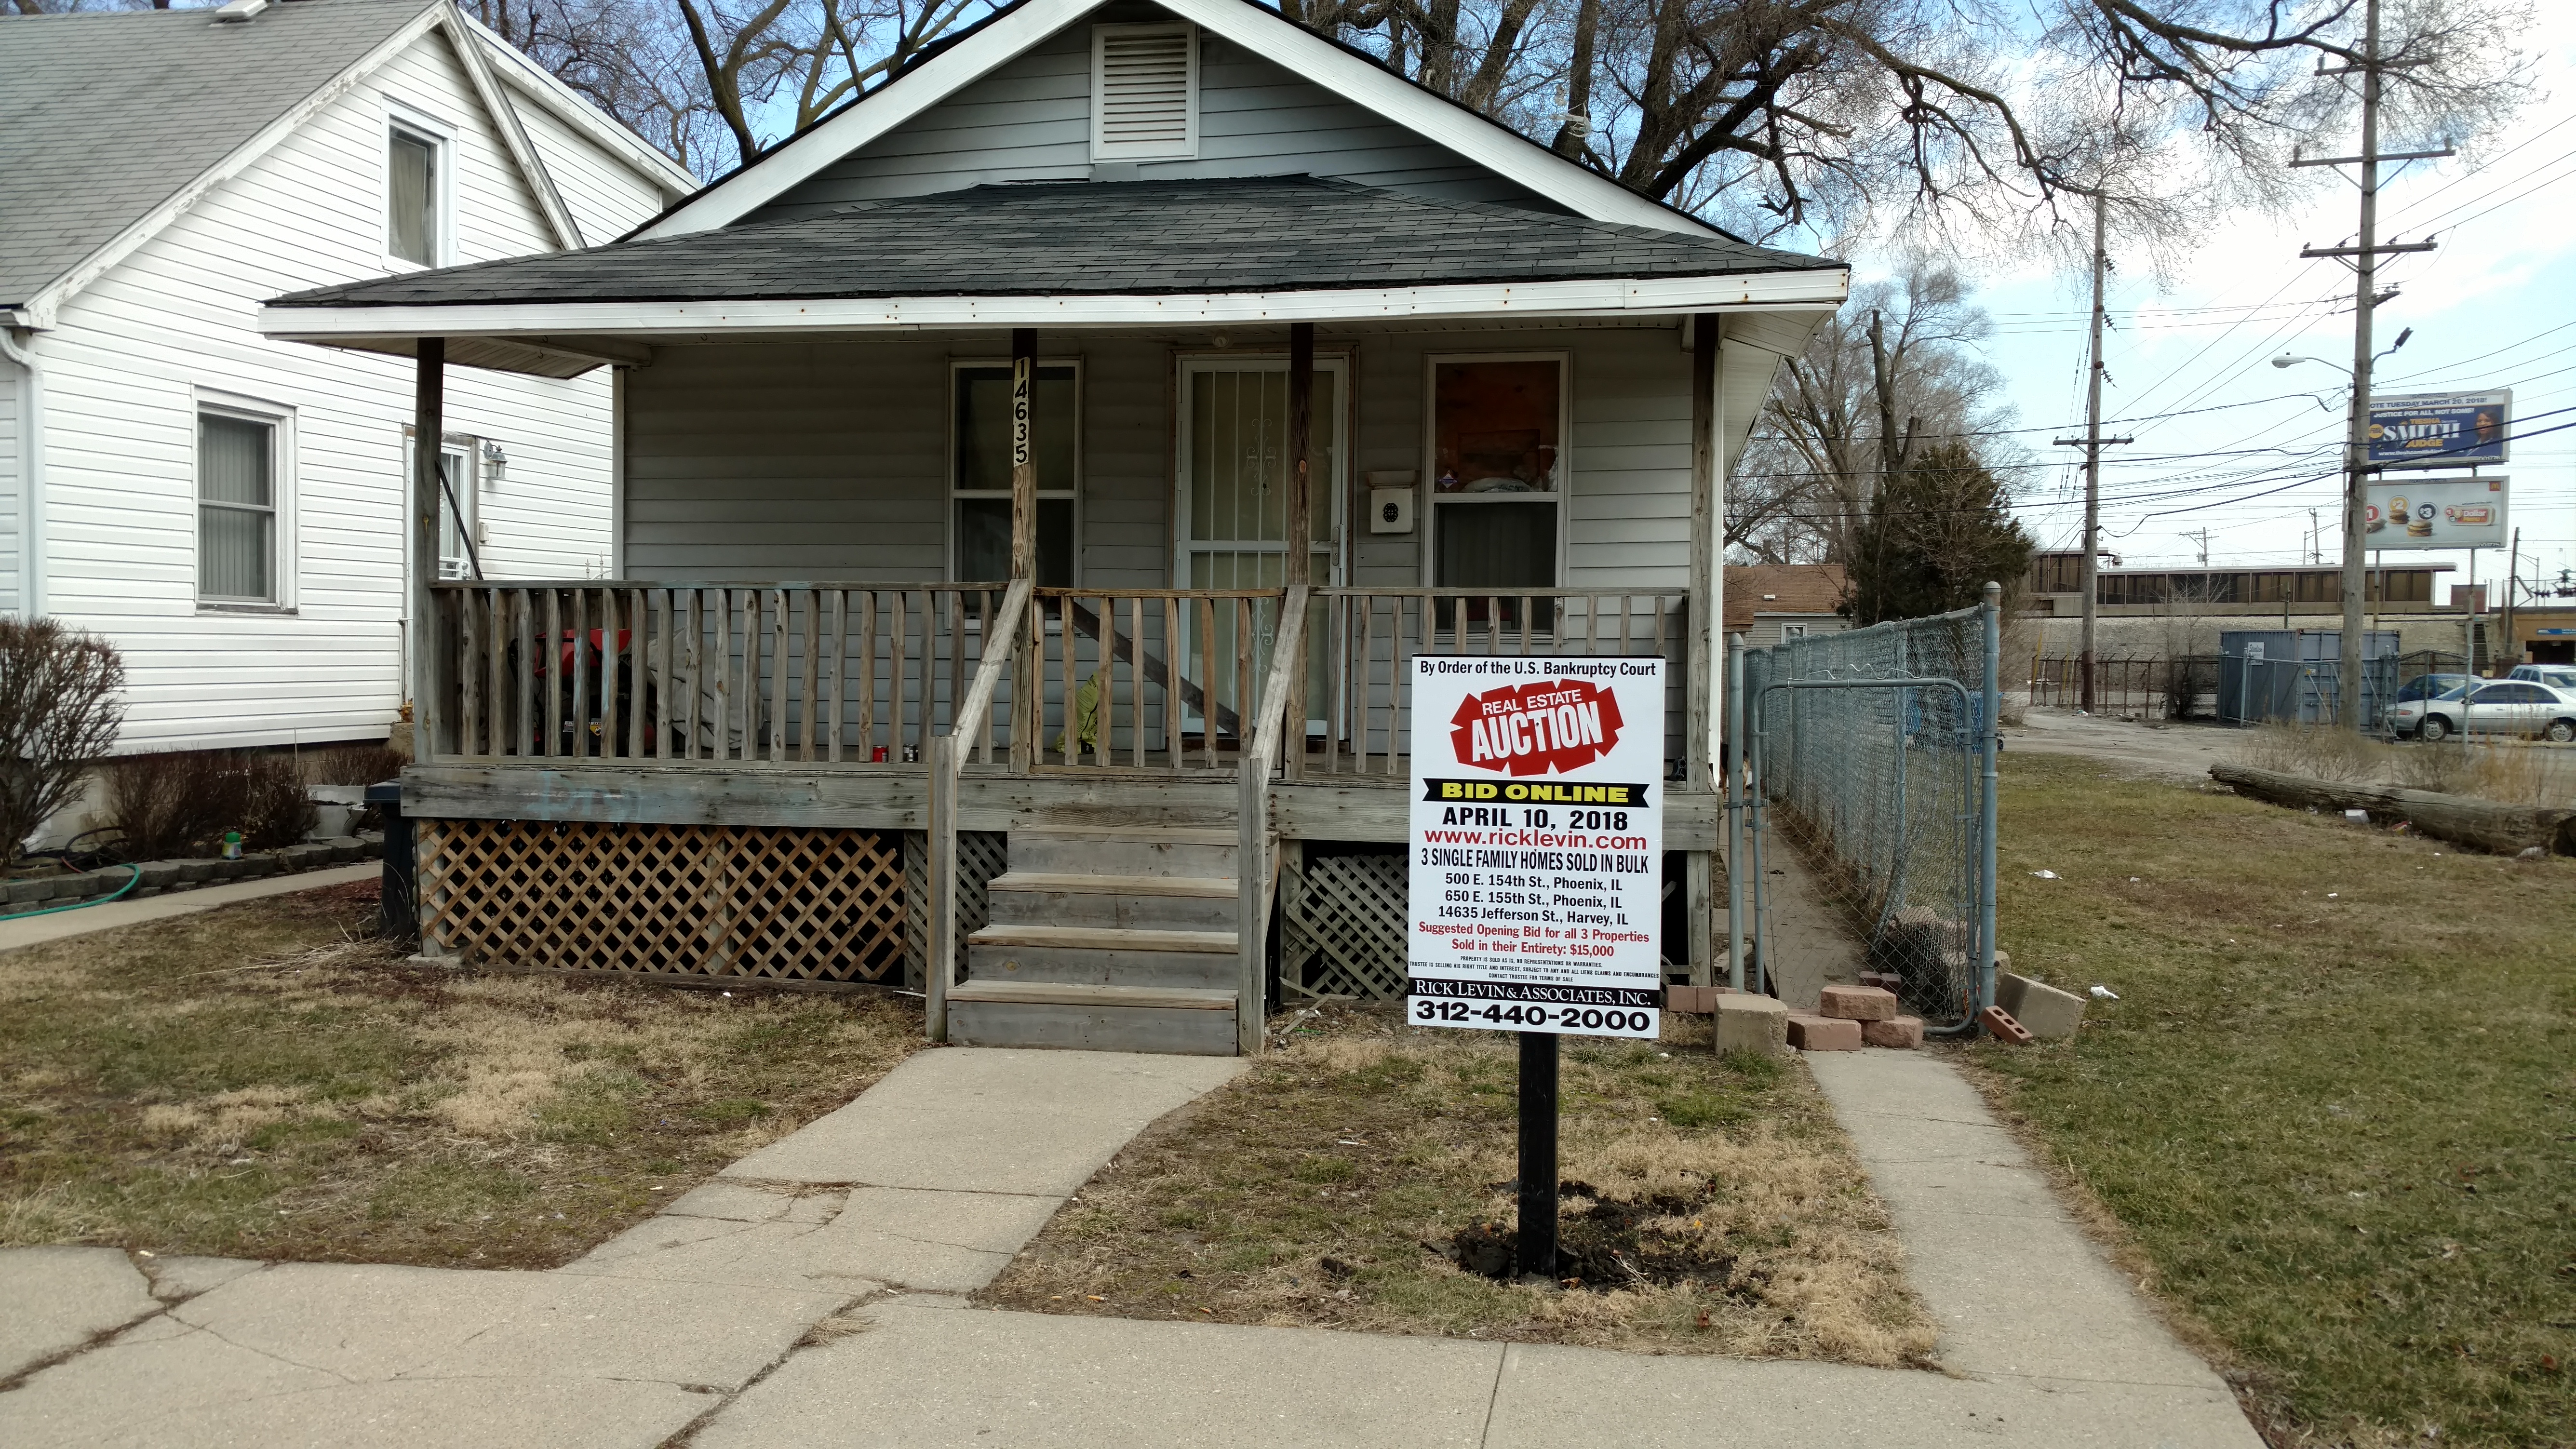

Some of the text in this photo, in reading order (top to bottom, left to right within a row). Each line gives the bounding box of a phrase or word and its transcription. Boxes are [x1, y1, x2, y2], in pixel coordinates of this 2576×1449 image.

[2383, 423, 2460, 441] SMITH
[2406, 439, 2443, 447] JUDGE
[2393, 500, 2404, 510] $2
[2420, 507, 2432, 516] $3
[1421, 660, 1656, 678] By Order of the U.S. Bankruptcy Court
[1482, 689, 1582, 716] REAL ESTATE
[1472, 701, 1603, 762] AUCTION
[1442, 783, 1628, 803] BID ONLINE
[1442, 807, 1627, 831] APRIL 10, 2018
[1424, 829, 1647, 849] www.ricklevin.com
[1421, 847, 1649, 874] 3 SINGLE FAMILY HOMES SOLD IN BULK
[1445, 872, 1623, 893] 500 E. 154th St., Phoenix, IL
[1445, 889, 1622, 910] 650 E. 155th St., Phoenix, IL
[1438, 905, 1628, 927] 14635 Jefferson St., Harvey, IL
[1419, 921, 1649, 943] Suggested Opening Bid for all 3 Properties
[1452, 938, 1614, 958] Sold in their Entirety: $15,000
[1415, 979, 1651, 1005] RICK LEVIN & ASSOCIATES, INC.
[1416, 1000, 1650, 1032] 312-440-2000
